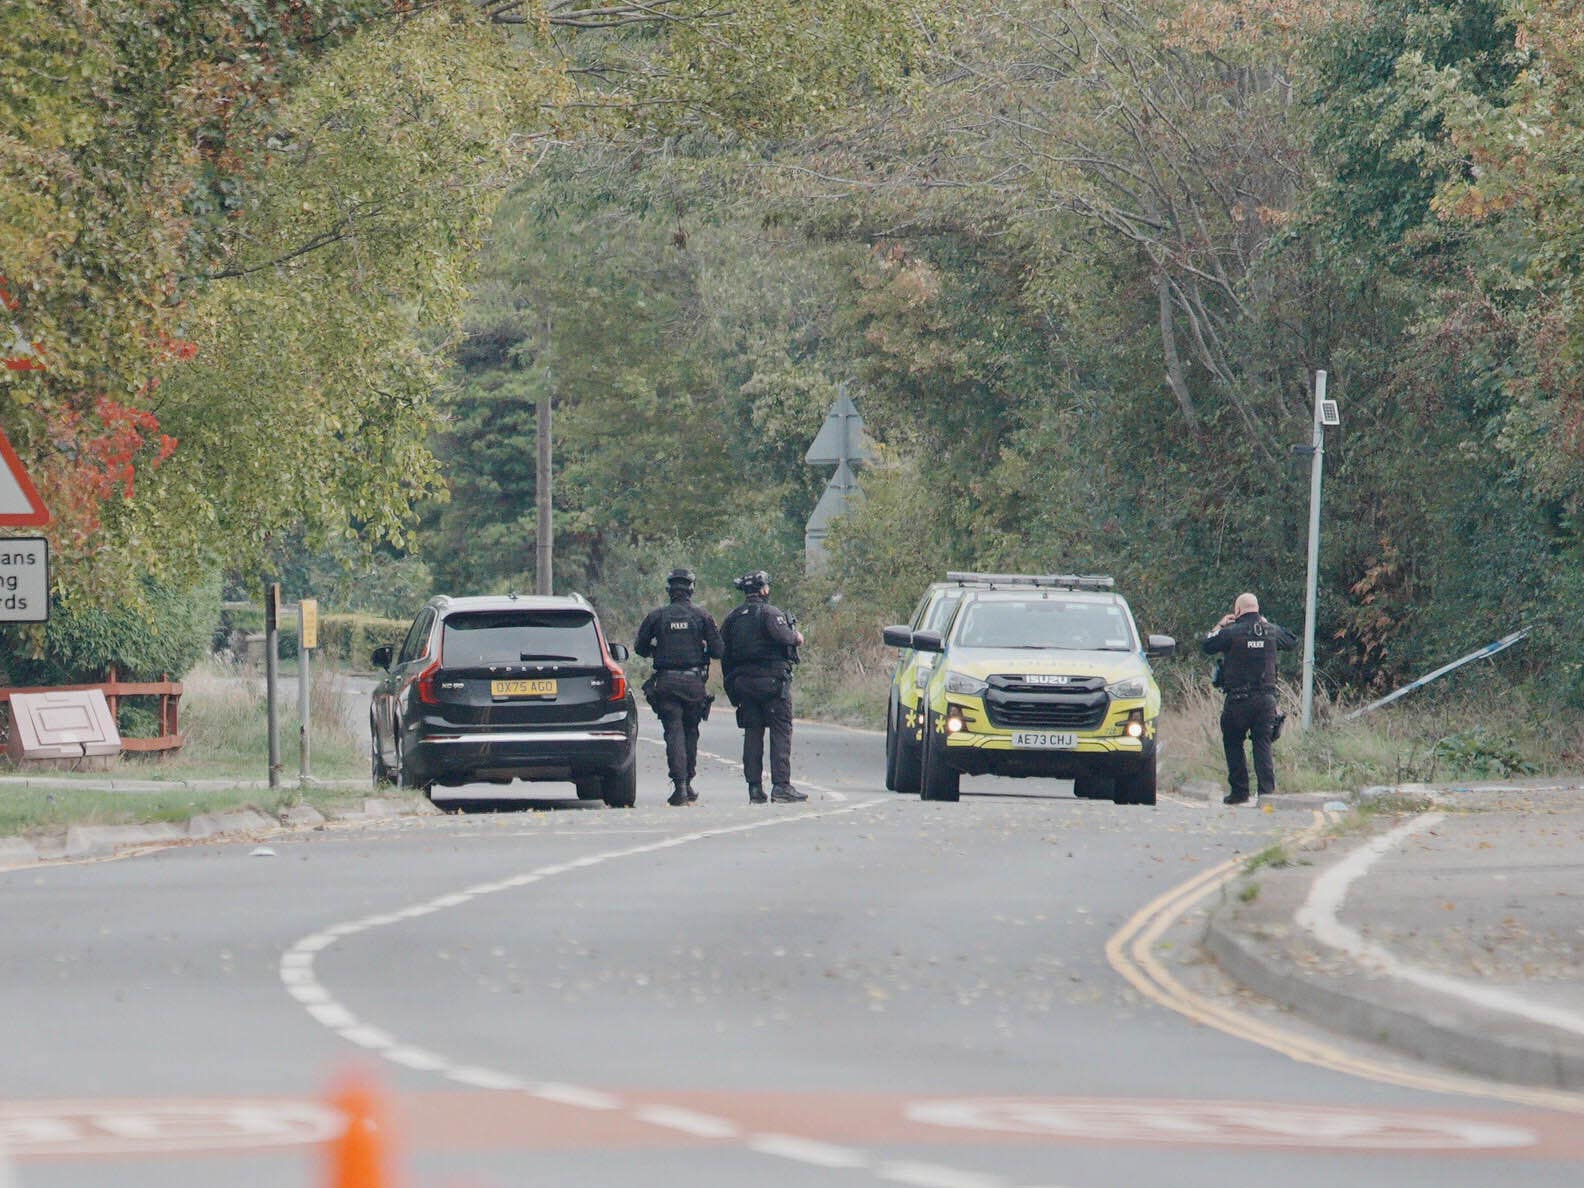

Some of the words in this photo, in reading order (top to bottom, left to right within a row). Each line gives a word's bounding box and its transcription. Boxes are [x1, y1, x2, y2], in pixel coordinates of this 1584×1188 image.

[1247, 640, 1265, 648] POLICE
[1026, 674, 1068, 685] ISUZU
[1017, 734, 1046, 745] AE73
[1050, 735, 1072, 745] CHJ
